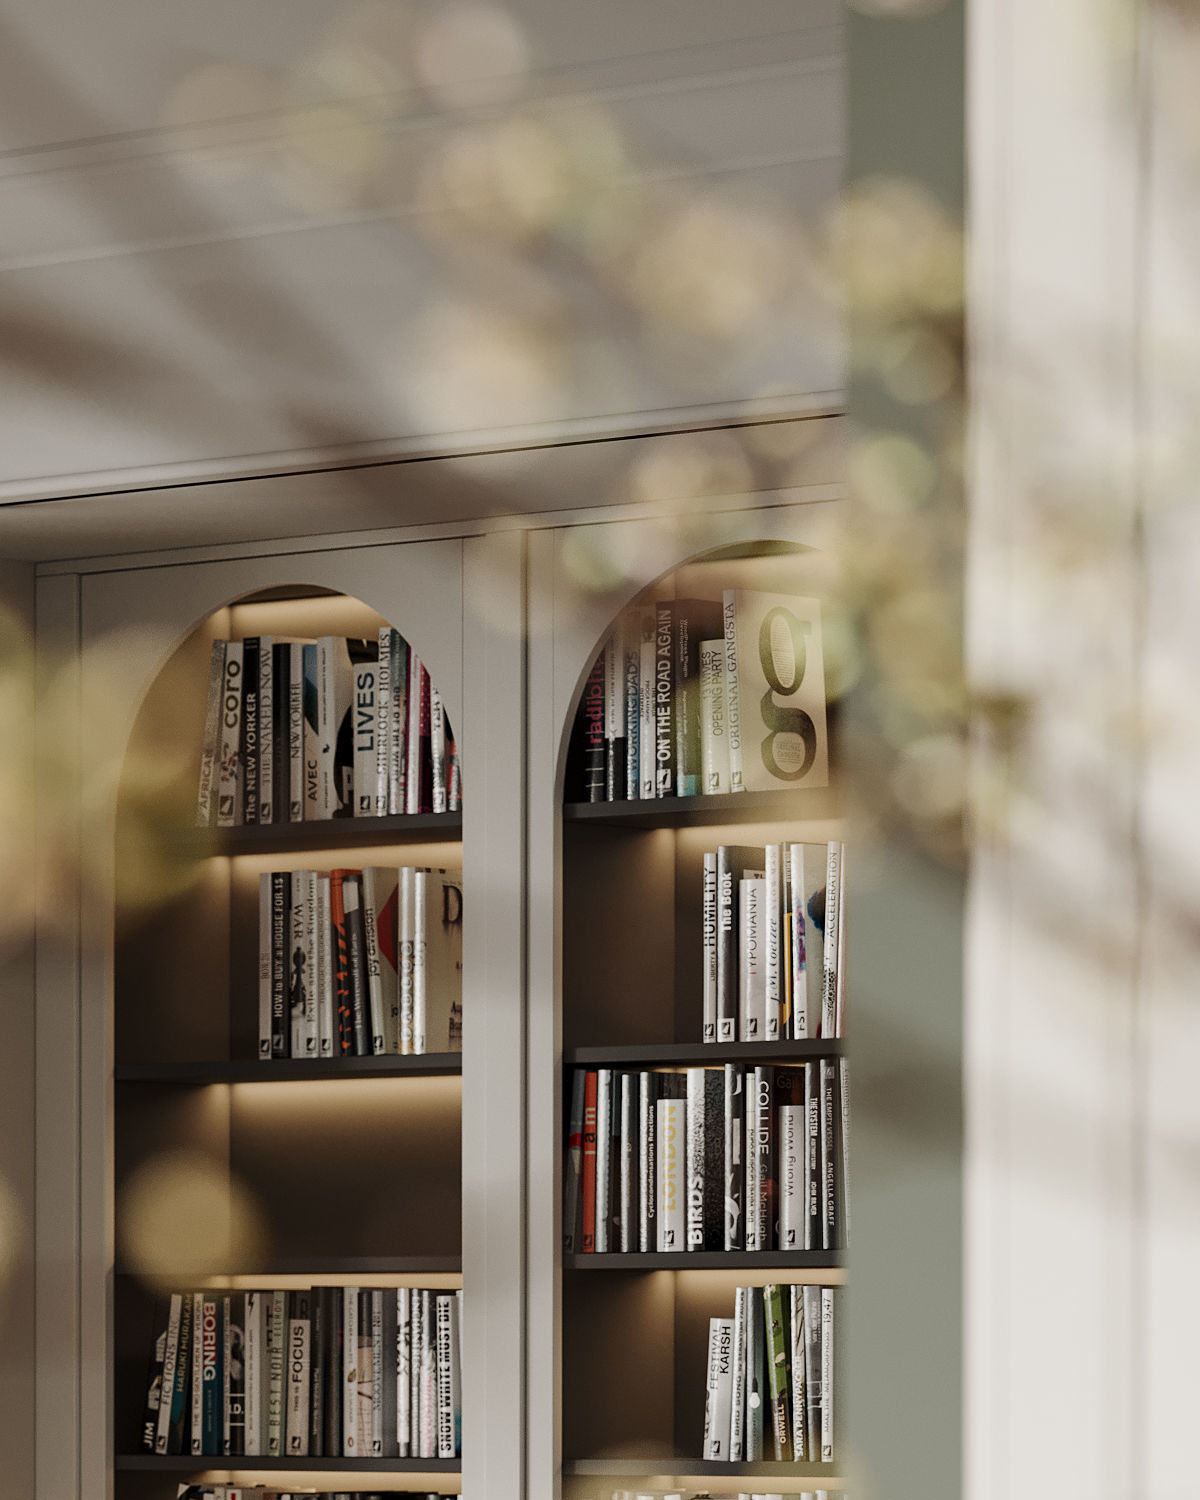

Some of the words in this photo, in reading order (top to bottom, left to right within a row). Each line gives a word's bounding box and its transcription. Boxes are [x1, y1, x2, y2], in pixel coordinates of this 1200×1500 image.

[657, 609, 672, 657] AGAIN
[725, 602, 737, 673] GANGSTA
[259, 648, 271, 689] NOW
[379, 632, 390, 692] HOLMES
[657, 660, 672, 702] ROAD
[710, 650, 722, 684] PARTY
[224, 659, 241, 729] coro
[290, 681, 300, 728] YORKER
[356, 671, 375, 752] LIVES
[711, 686, 723, 736] OPENING
[728, 676, 740, 750] ORIGINAL
[759, 606, 817, 782] g
[247, 692, 258, 753] YORKER
[260, 696, 272, 755] NAKED
[376, 699, 389, 775] SHERLOCK
[628, 697, 638, 771] WORKING
[657, 705, 672, 737] THE
[290, 732, 301, 759] NEW
[657, 739, 672, 761] ON
[246, 757, 257, 790] NEW
[262, 760, 271, 785] THE
[307, 760, 318, 801] AVEC
[245, 794, 256, 821] The
[273, 892, 283, 912] FOR
[307, 879, 315, 934] Kingdom
[704, 867, 716, 947] HUMILITY
[721, 872, 732, 905] Book
[827, 852, 838, 938] ACCELERATION
[273, 914, 283, 947] HOUSE
[294, 904, 304, 940] WAR
[365, 907, 375, 956] division
[722, 908, 732, 932] The
[273, 960, 283, 980] BUY
[369, 959, 380, 977] joy
[273, 995, 284, 1018] HOW
[758, 1080, 770, 1154] COLLIDE
[661, 1105, 677, 1212] LONDON
[784, 1155, 795, 1197] Wrong
[687, 1173, 704, 1245] BIRDS
[758, 1191, 768, 1241] McHugh
[827, 1199, 835, 1226] GRAFF
[438, 1301, 450, 1323] DIE
[203, 1301, 216, 1381] BORING
[292, 1326, 304, 1383] FOCUS
[439, 1326, 450, 1362] MUST
[709, 1324, 721, 1390] FESTIVAL
[719, 1325, 731, 1374] KARSH
[161, 1344, 177, 1405] FICTIONS
[175, 1351, 187, 1393] HARUKI
[271, 1347, 283, 1381] NOIR
[440, 1366, 451, 1408] WHITE
[143, 1422, 155, 1449] JIM
[440, 1411, 452, 1451] SNOW
[777, 1403, 788, 1444] ORWELL
[795, 1429, 804, 1457] SARA
